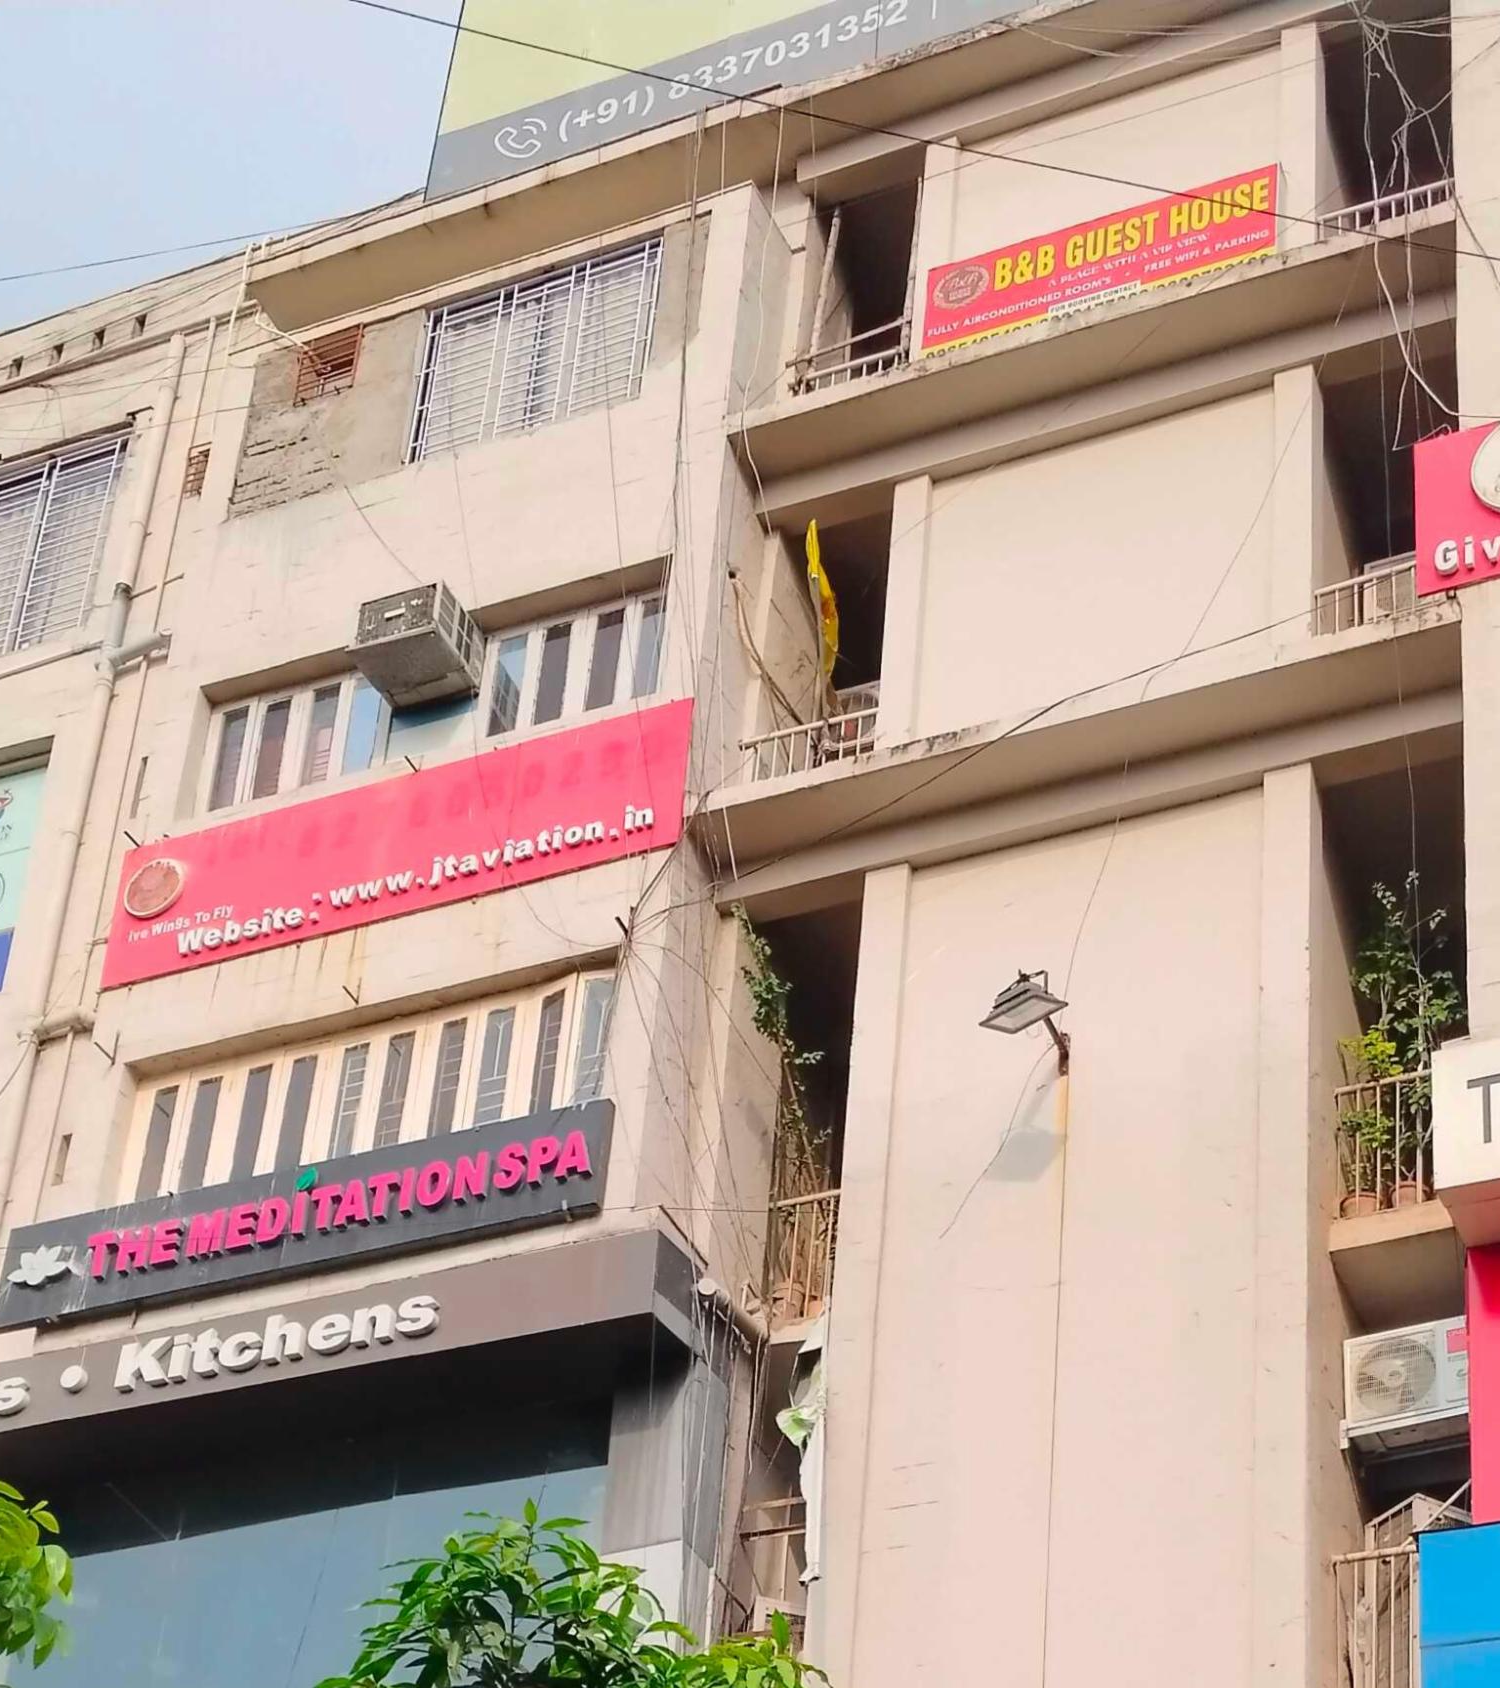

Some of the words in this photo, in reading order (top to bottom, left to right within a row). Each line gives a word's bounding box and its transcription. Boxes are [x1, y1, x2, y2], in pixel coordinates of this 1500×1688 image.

[558, 86, 654, 141] (+91)
[669, 1, 907, 100] 8337031352
[927, 322, 958, 338] FULLY
[962, 291, 1061, 327] AIRCONDITIONED
[1215, 229, 1270, 251] PARKING
[993, 244, 1055, 291] B&B
[1065, 211, 1160, 269] GUEST
[1169, 177, 1270, 238] HOUSE
[329, 803, 658, 912] www.jtaviation.in
[85, 1219, 184, 1282] THE
[183, 1149, 492, 1261] MEDITATION
[494, 1129, 594, 1194] SPA
[112, 1287, 441, 1395] Kitchens
